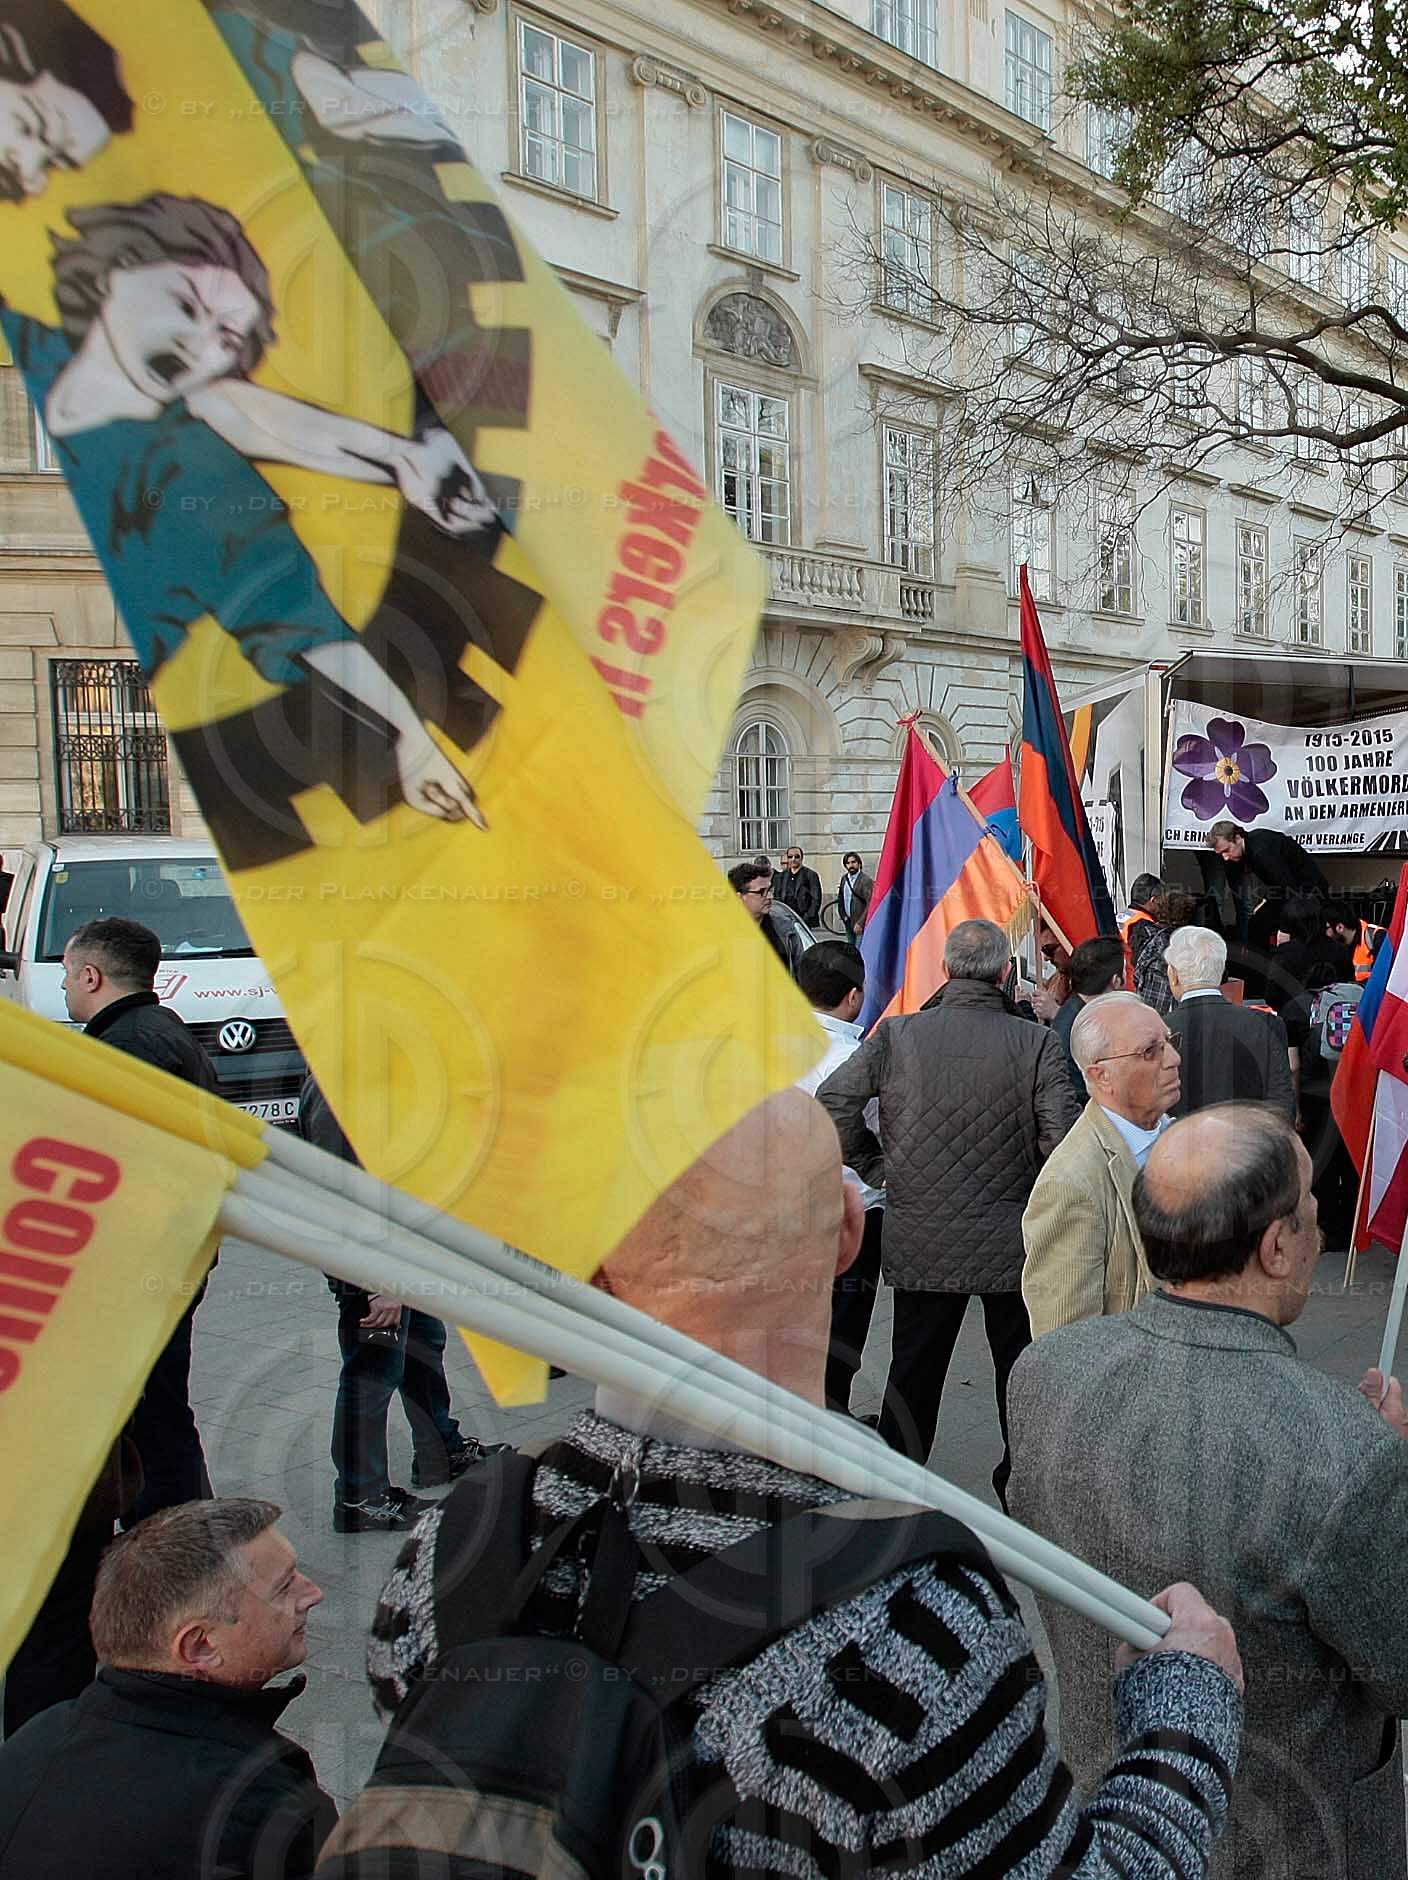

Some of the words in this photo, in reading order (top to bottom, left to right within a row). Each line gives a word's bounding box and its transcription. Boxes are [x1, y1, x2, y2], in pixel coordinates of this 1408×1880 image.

[1304, 729, 1394, 748] 1915-2015
[1306, 755, 1338, 772] 100
[1343, 750, 1393, 770] JAHRE
[1284, 806, 1304, 820] AN
[1309, 804, 1337, 820] DEN
[1165, 829, 1181, 841] CH
[1315, 832, 1365, 845] VERLANGE
